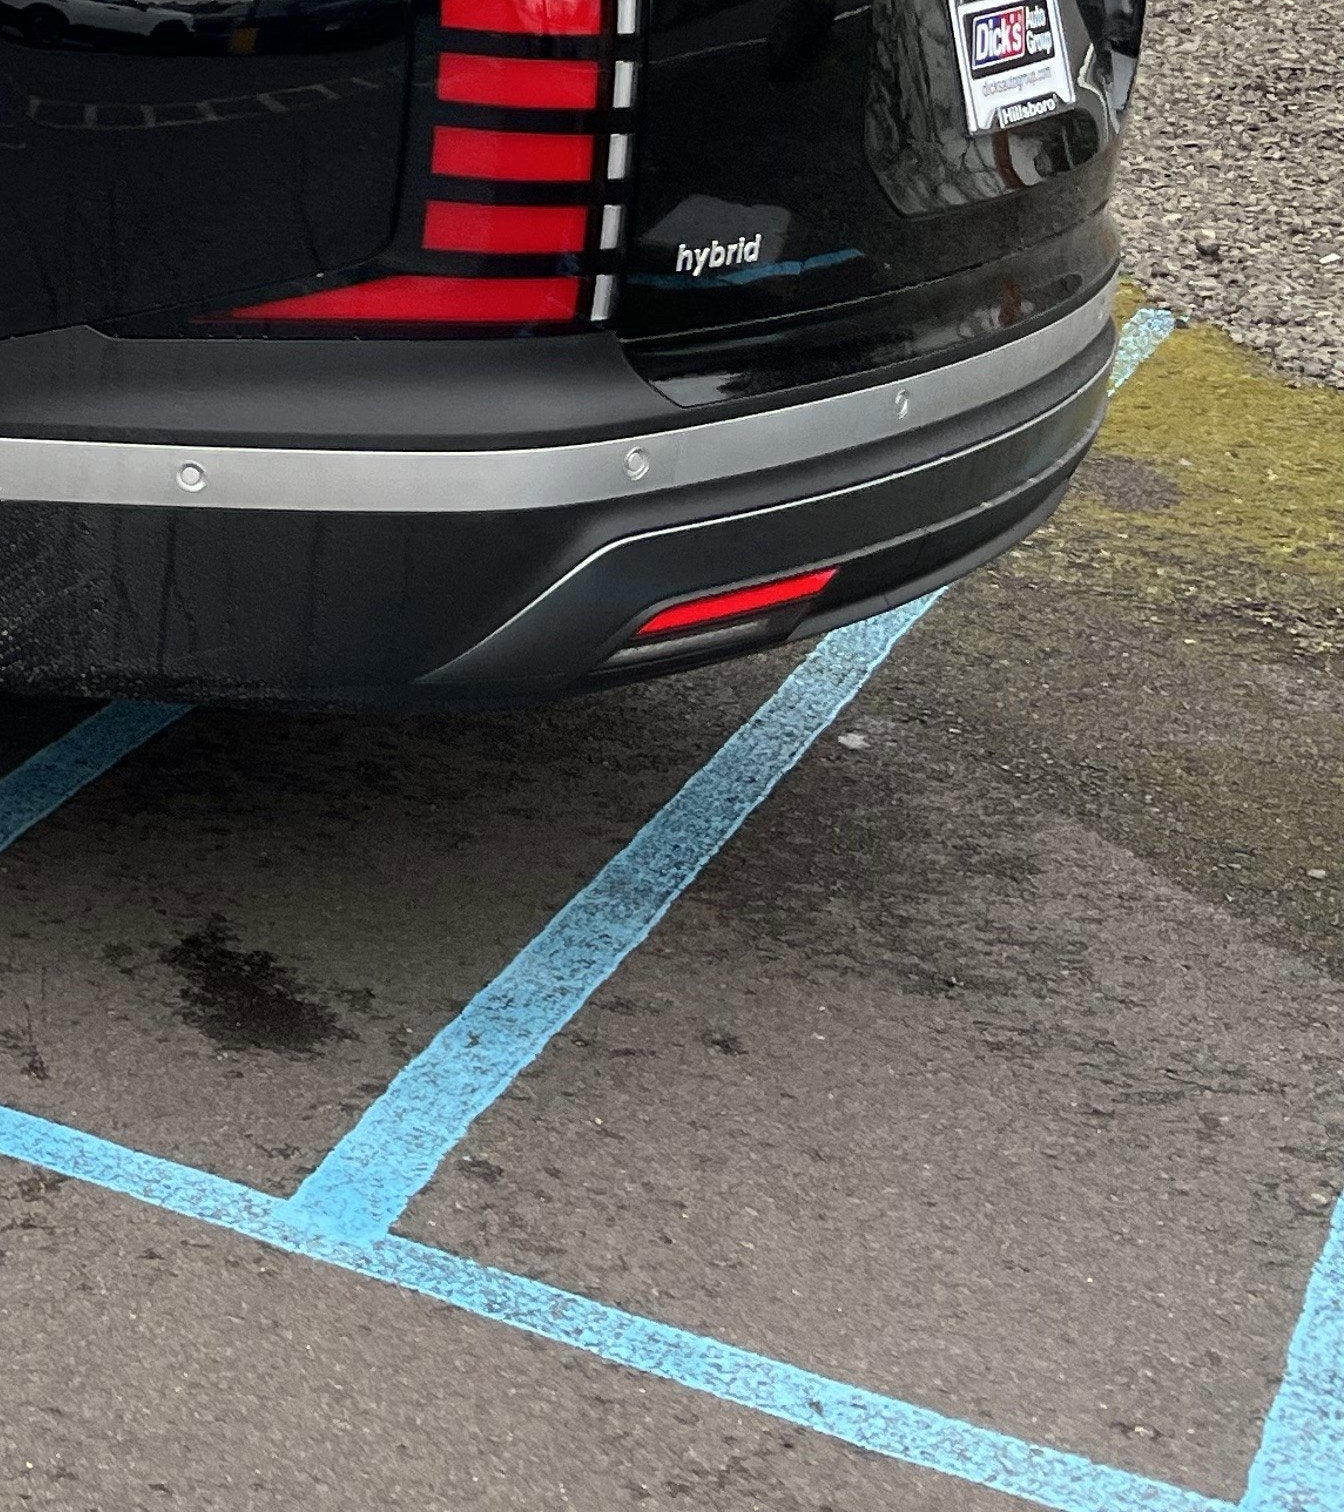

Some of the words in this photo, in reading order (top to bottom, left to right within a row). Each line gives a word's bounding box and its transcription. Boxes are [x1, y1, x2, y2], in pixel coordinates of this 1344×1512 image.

[975, 12, 1023, 62] Dick's
[1001, 97, 1057, 125] Hillsboro
[675, 233, 762, 277] hybrid
